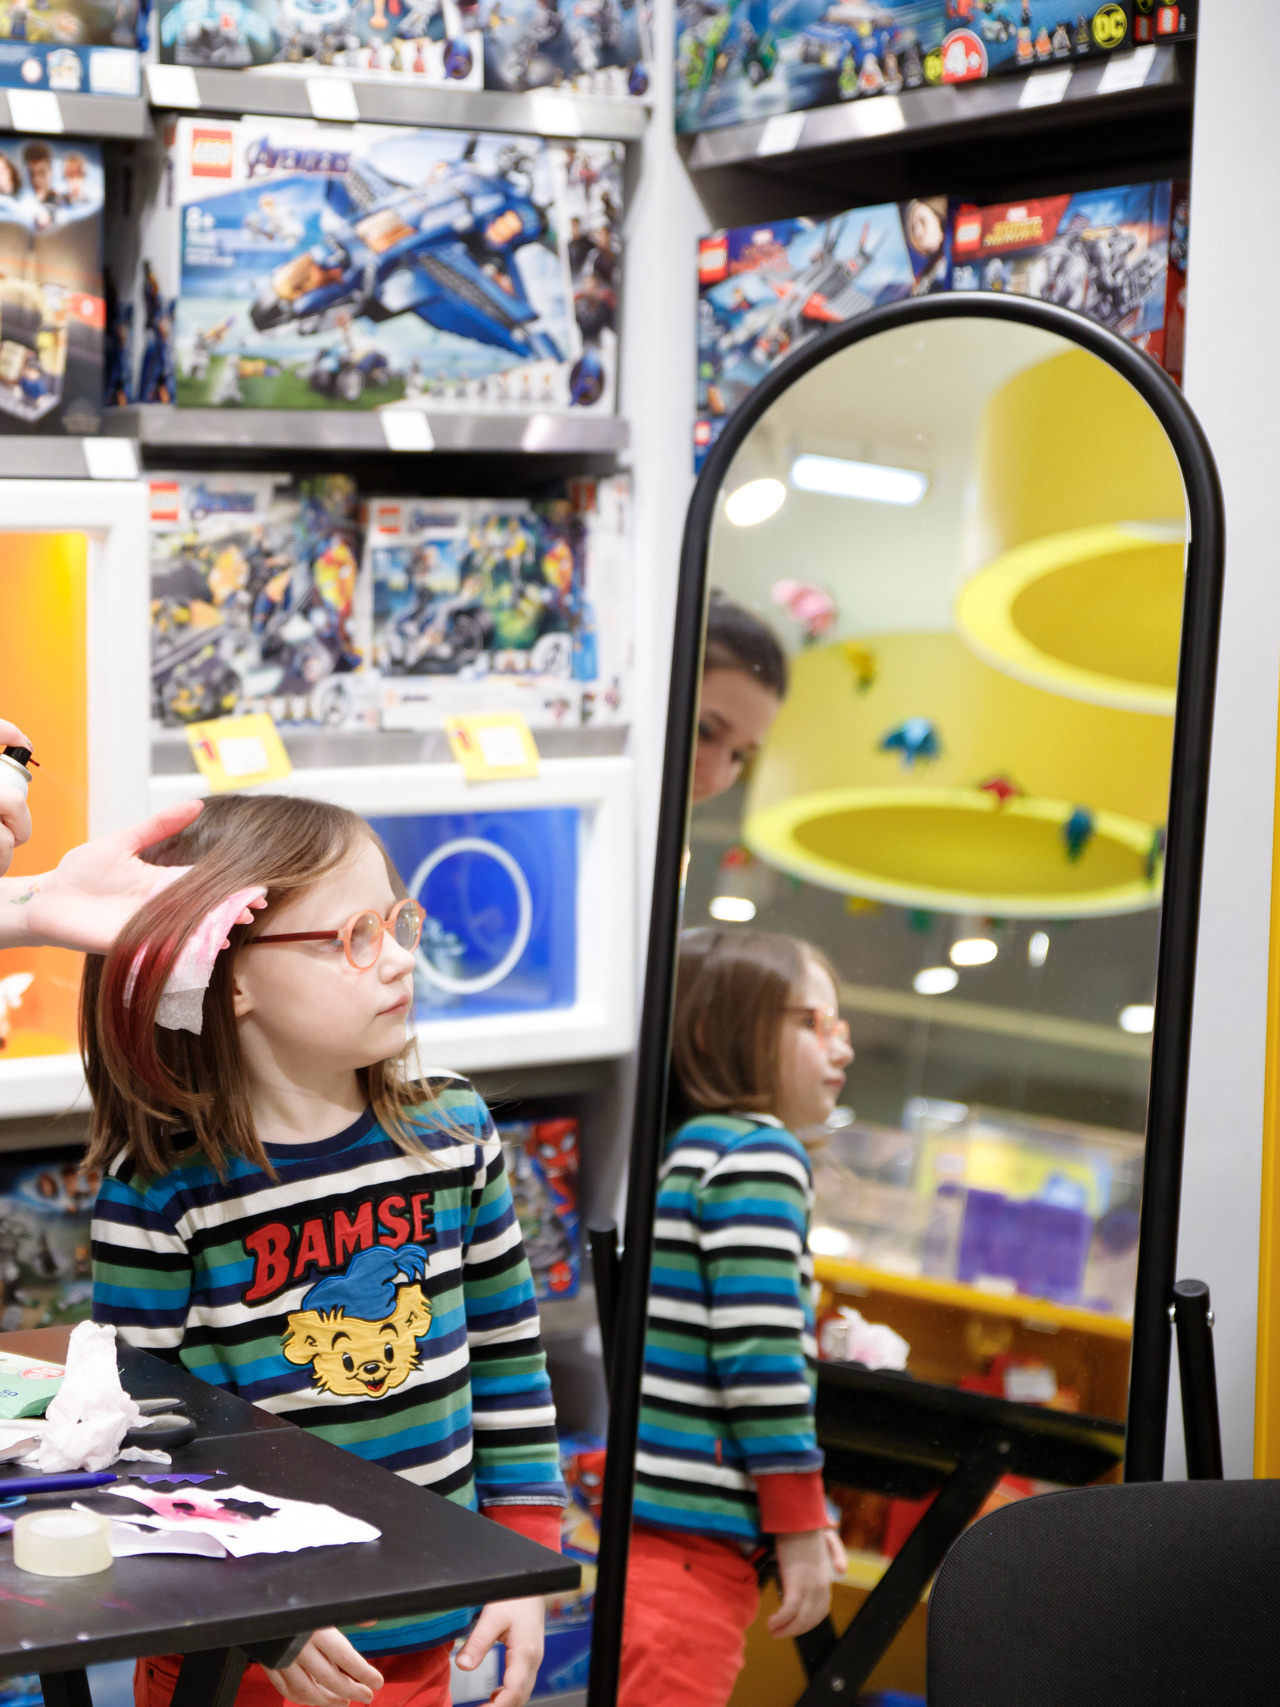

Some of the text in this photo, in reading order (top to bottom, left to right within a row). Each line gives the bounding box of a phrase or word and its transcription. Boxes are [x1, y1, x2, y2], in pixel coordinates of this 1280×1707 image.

[1096, 13, 1124, 38] DC
[245, 1193, 430, 1301] BAMSE
[1, 1389, 19, 1397] 50
